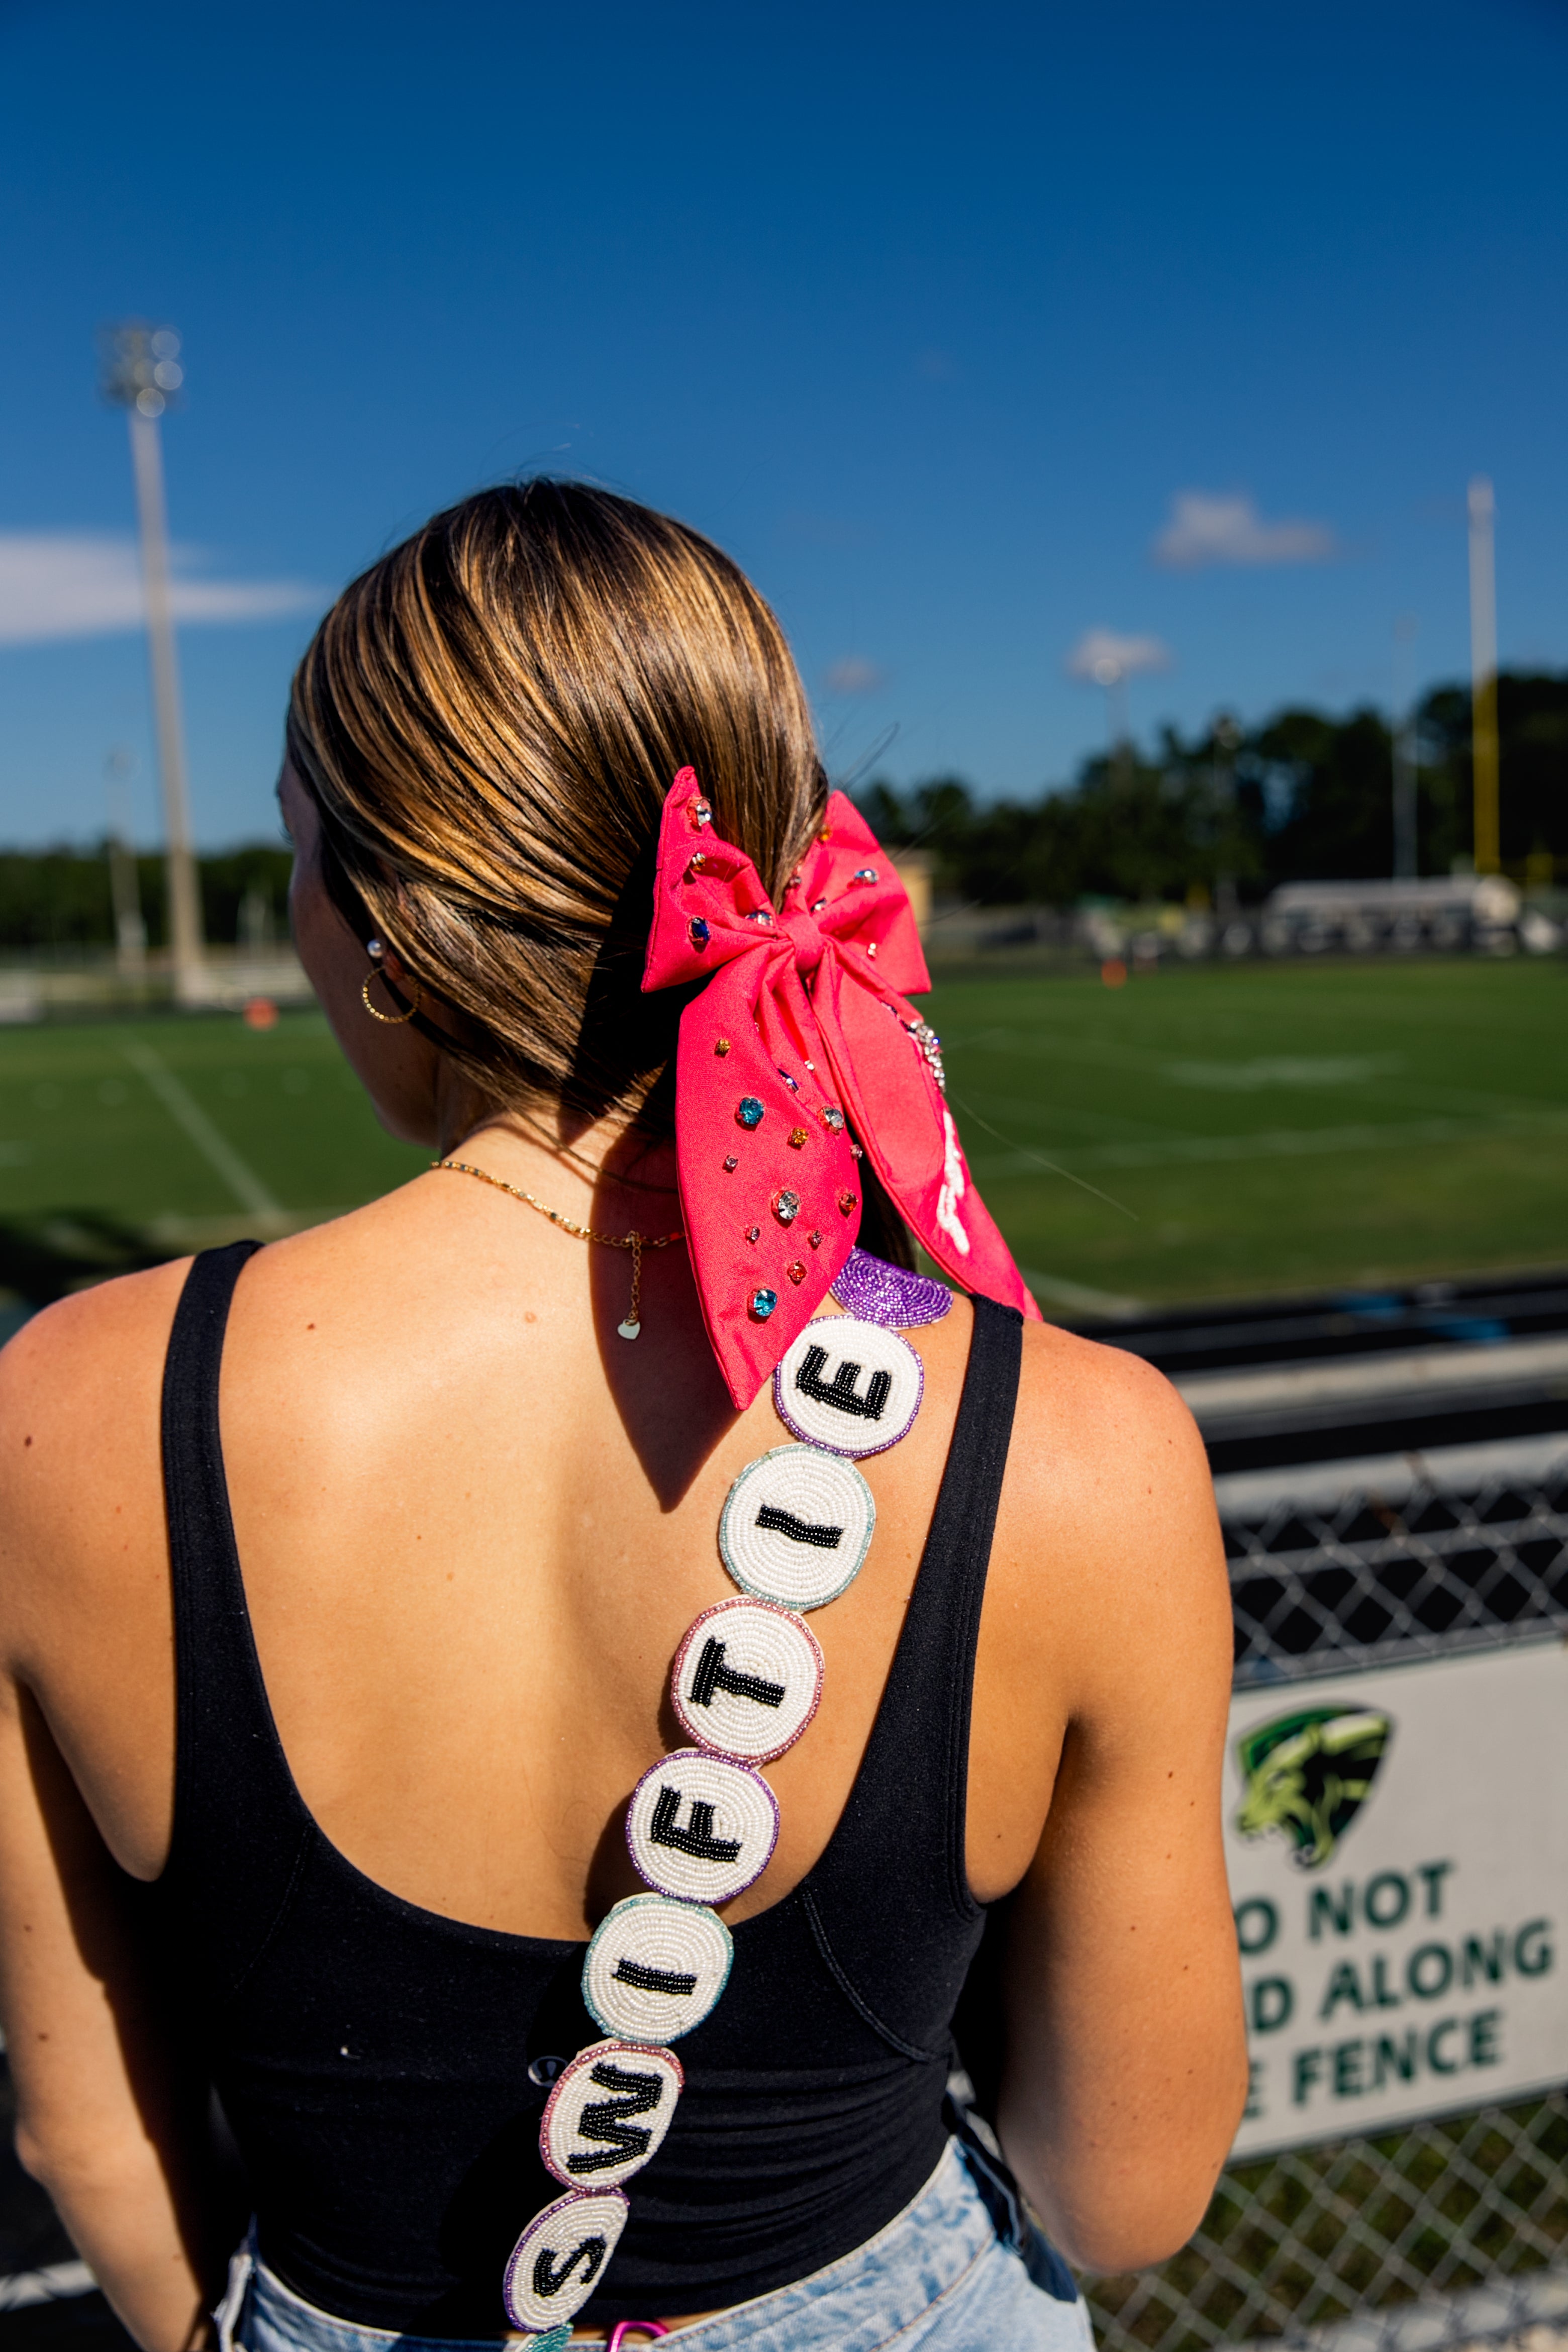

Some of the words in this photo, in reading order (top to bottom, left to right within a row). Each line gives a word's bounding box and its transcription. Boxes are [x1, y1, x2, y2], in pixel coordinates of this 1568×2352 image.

[533, 1344, 893, 2297] SWIFTIE
[1234, 1897, 1279, 1956] O
[1308, 1860, 1454, 1942] NOT
[1319, 1918, 1553, 2022] ALONG
[1292, 2009, 1502, 2107] FENCE
